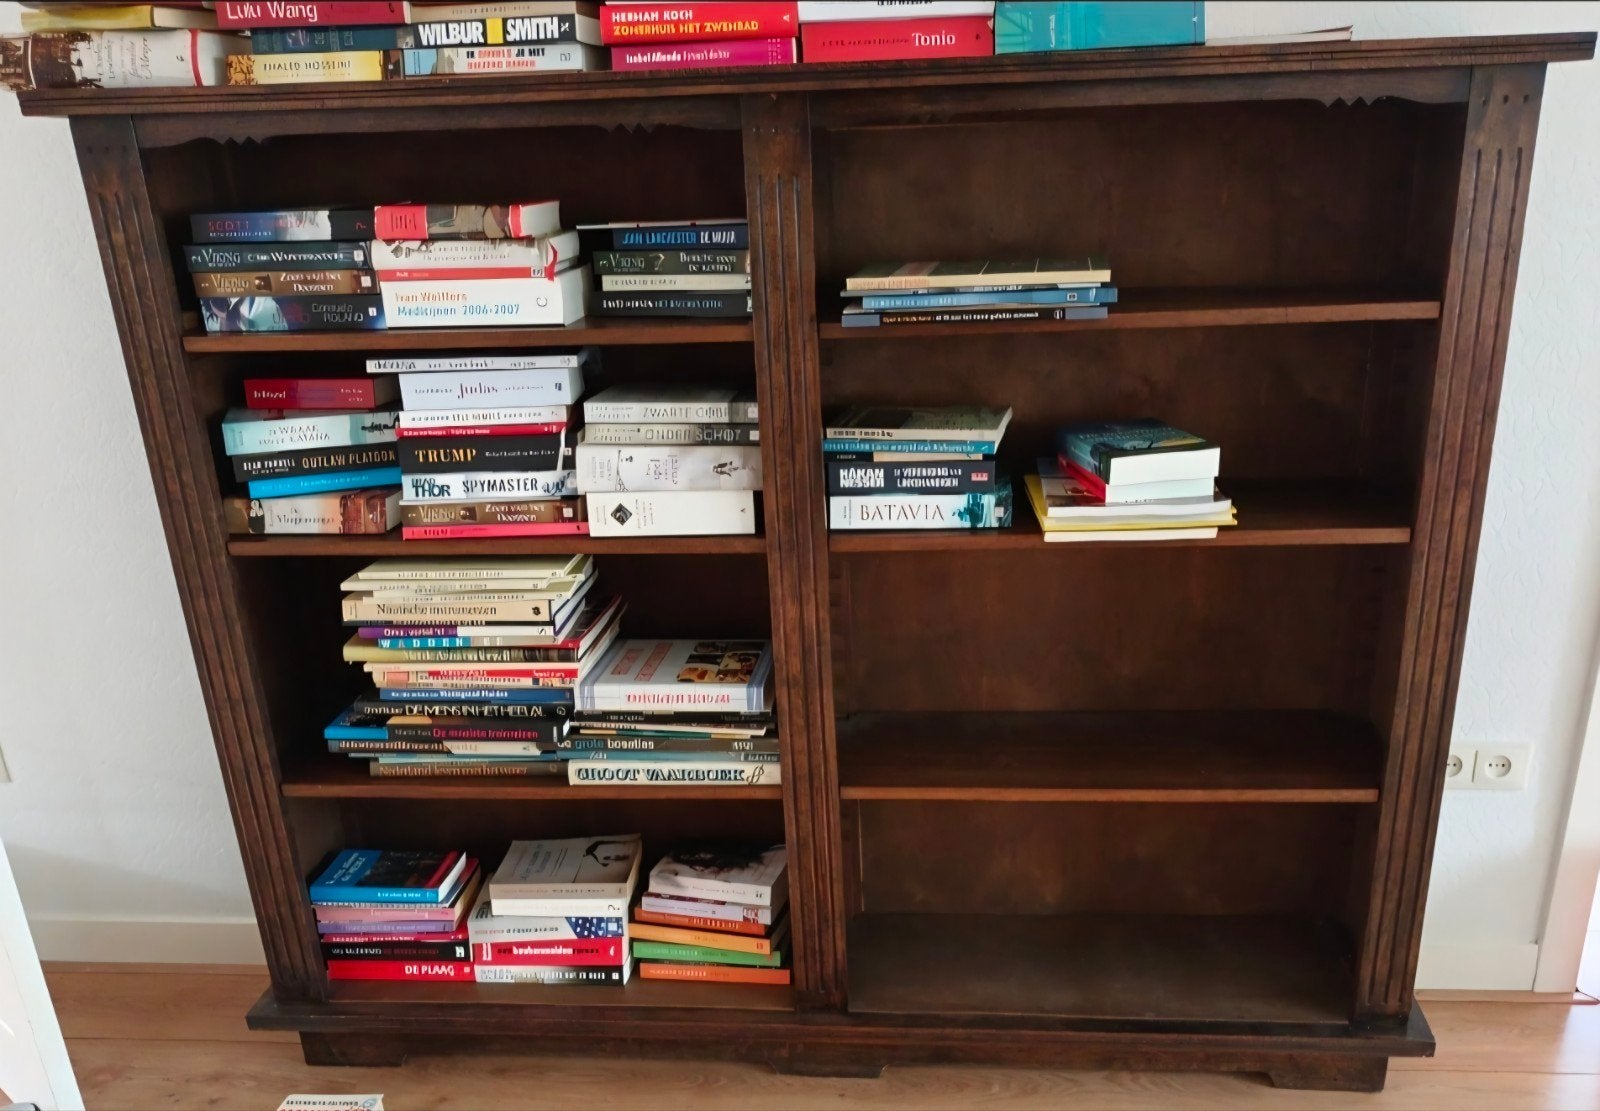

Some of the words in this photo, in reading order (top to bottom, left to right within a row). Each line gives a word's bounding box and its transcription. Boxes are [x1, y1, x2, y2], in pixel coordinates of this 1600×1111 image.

[265, 2, 318, 22] Wang
[664, 9, 693, 20] KOCH
[418, 22, 485, 46] WILBUR
[507, 16, 559, 42] SMITH
[912, 30, 956, 47] Tonio
[302, 455, 346, 469] OUTLAW
[415, 448, 477, 463] TRUMP
[411, 484, 451, 498] THOR
[462, 477, 538, 493] SPYMASTER
[859, 504, 945, 521] BATAVIA
